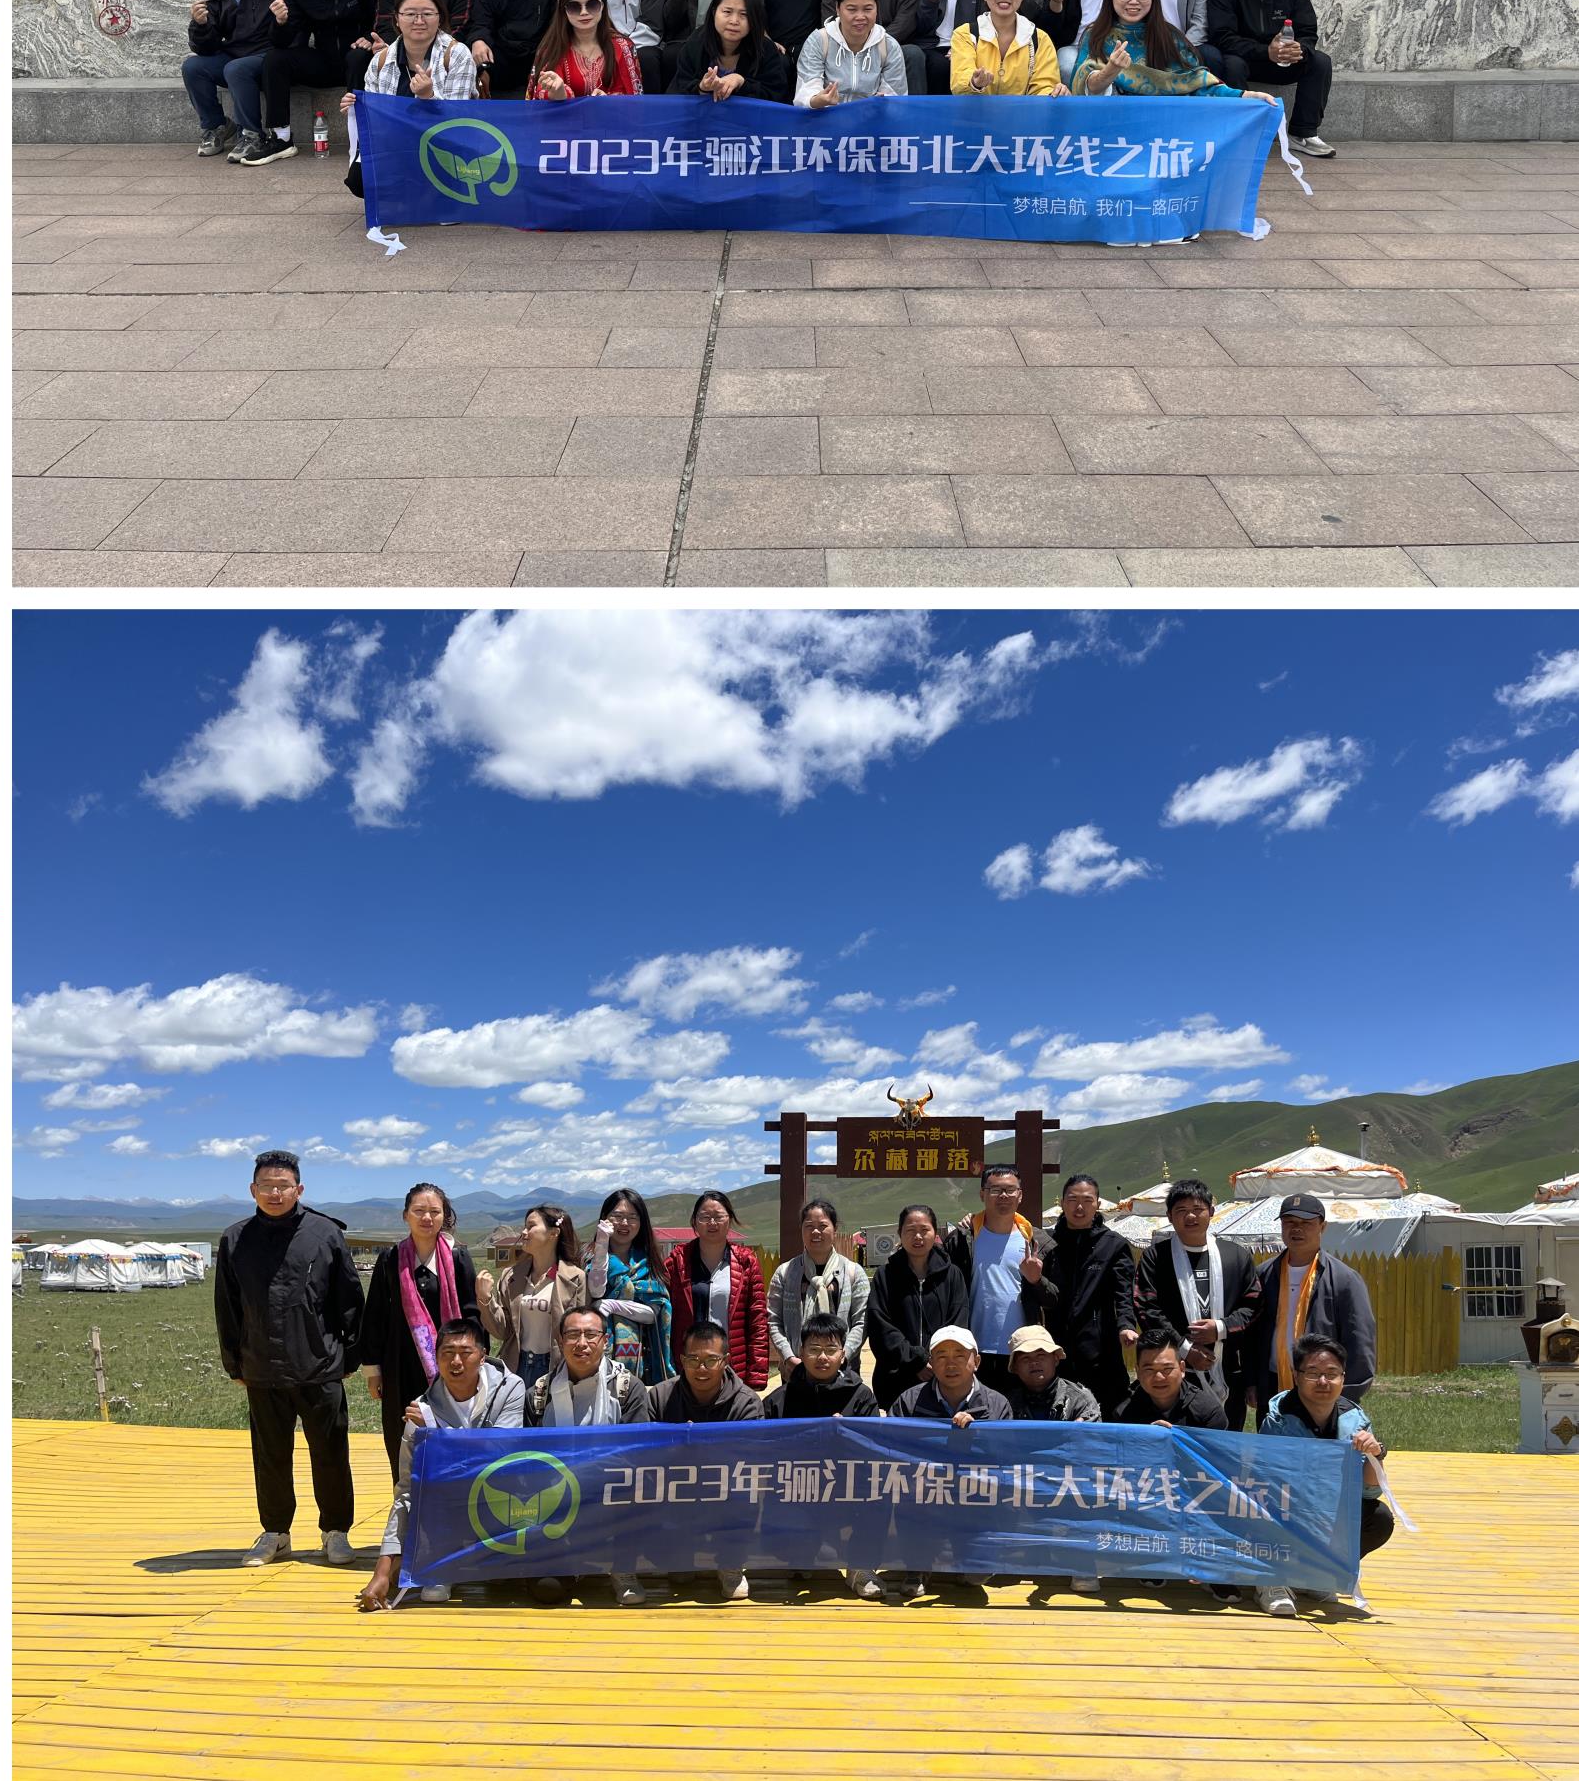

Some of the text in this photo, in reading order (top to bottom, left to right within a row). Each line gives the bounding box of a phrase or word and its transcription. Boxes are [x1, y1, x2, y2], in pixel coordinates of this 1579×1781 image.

[538, 135, 1215, 179] 2023年骊江环保西北大环线之旅！
[1012, 196, 1200, 218] 梦想启航 我们一路同行
[853, 1148, 970, 1171] 尕藏部落
[602, 1459, 1291, 1522] 2023年骊江环保西北大环线之旅！
[1095, 1532, 1293, 1562] 梦想启航 我们一路同行
